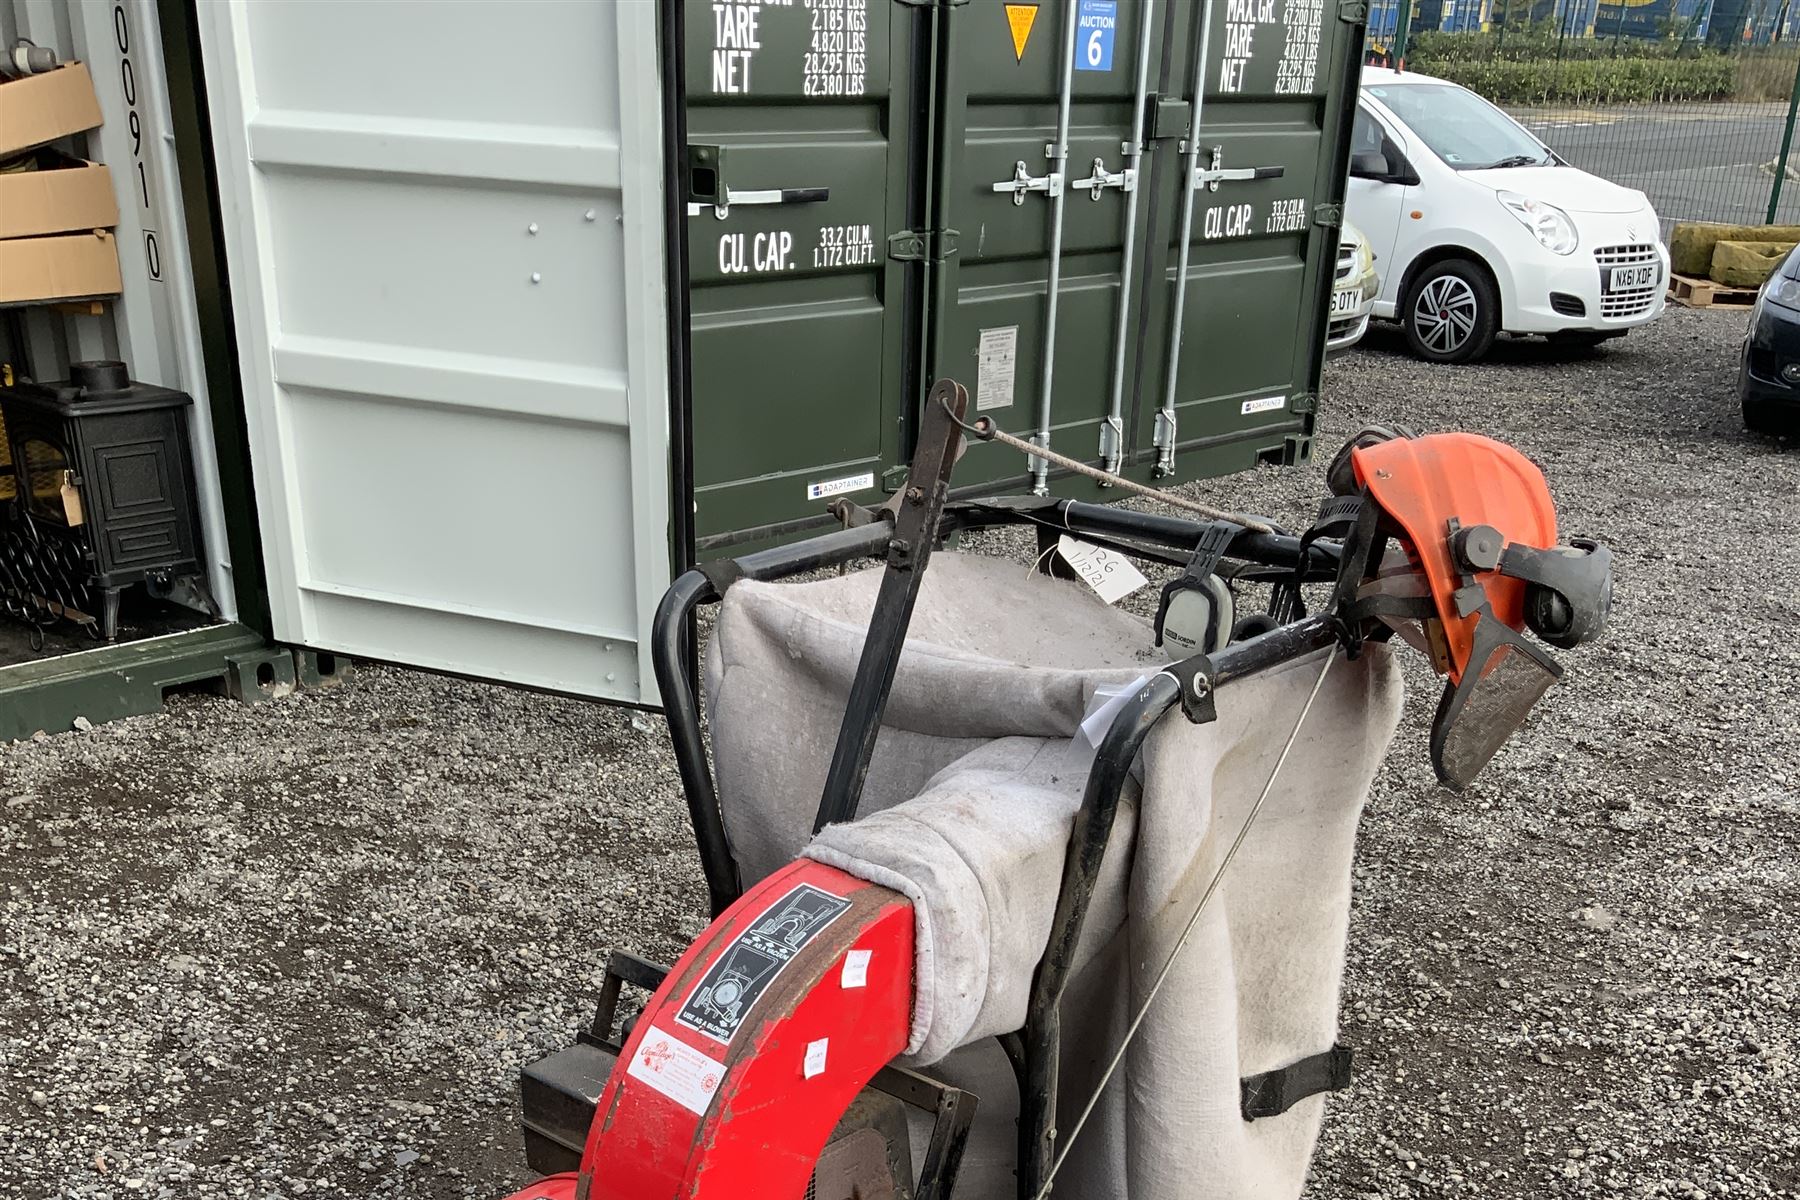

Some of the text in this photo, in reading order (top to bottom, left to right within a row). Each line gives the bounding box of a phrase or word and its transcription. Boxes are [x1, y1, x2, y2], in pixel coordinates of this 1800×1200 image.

[713, 4, 761, 48] TARE
[846, 10, 866, 31] KGS
[1080, 15, 1115, 28] AUCTION
[1309, 9, 1323, 26] LBS
[846, 31, 865, 52] LBS
[1087, 29, 1103, 66] 6
[1225, 24, 1256, 57] TARE
[1307, 26, 1321, 43] KGS
[1305, 43, 1319, 60] LBS
[712, 50, 752, 93] NET
[846, 53, 865, 73] KGS
[1219, 59, 1247, 92] NET
[1303, 60, 1317, 77] KGS
[845, 75, 865, 95] LBS
[1301, 77, 1314, 94] LBS
[1204, 206, 1223, 239] CU.
[1225, 204, 1252, 237] CAP.
[719, 224, 873, 273] CU. CAP. 33.2 CU.M.
[845, 244, 876, 265] CU.FT.
[1615, 267, 1653, 288] NX61 XDF
[1339, 290, 1359, 310] OTY
[823, 477, 868, 493] ADAPTAINER
[1089, 546, 1119, 573] 126
[683, 1011, 695, 1021] USE
[694, 1016, 704, 1024] AS
[707, 1022, 730, 1037] BLOWER
